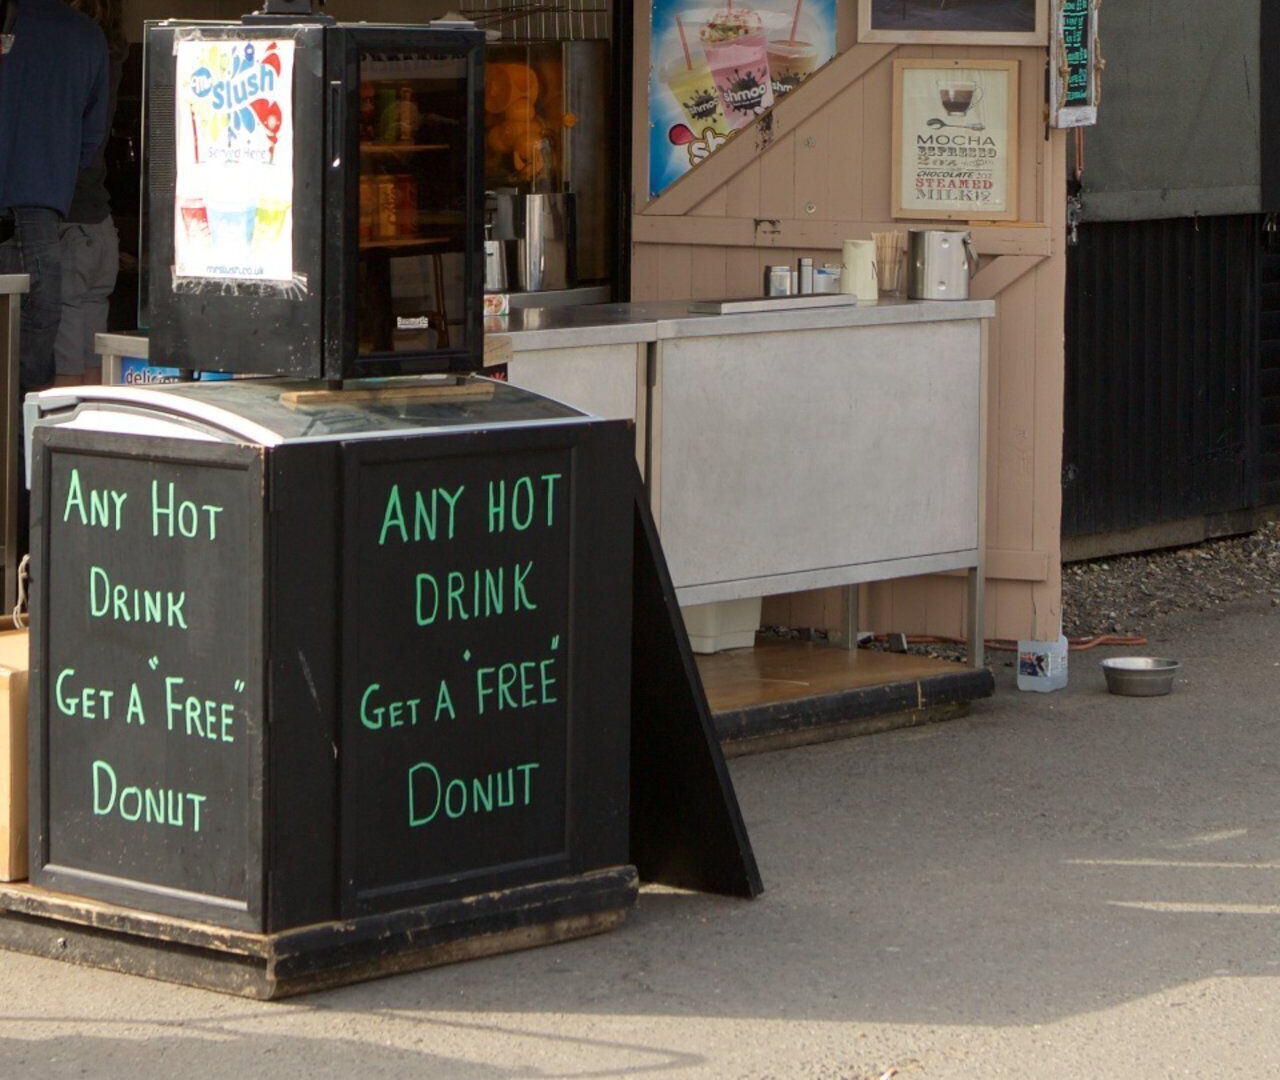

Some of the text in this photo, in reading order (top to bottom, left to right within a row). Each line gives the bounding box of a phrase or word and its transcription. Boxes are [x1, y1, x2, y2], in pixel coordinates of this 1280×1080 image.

[723, 83, 766, 103] shmoo
[917, 134, 995, 146] MOCHA
[916, 178, 993, 189] STEAMED
[64, 469, 223, 541] ANY HOT
[379, 473, 562, 545] ANY HOT
[90, 566, 188, 629] DRINK
[416, 560, 537, 627] DRINK
[56, 668, 114, 719] GET
[127, 683, 145, 725] A
[360, 683, 421, 730] GET
[435, 680, 455, 721] A
[92, 760, 207, 832] DONUT
[409, 762, 540, 827] DONUT
